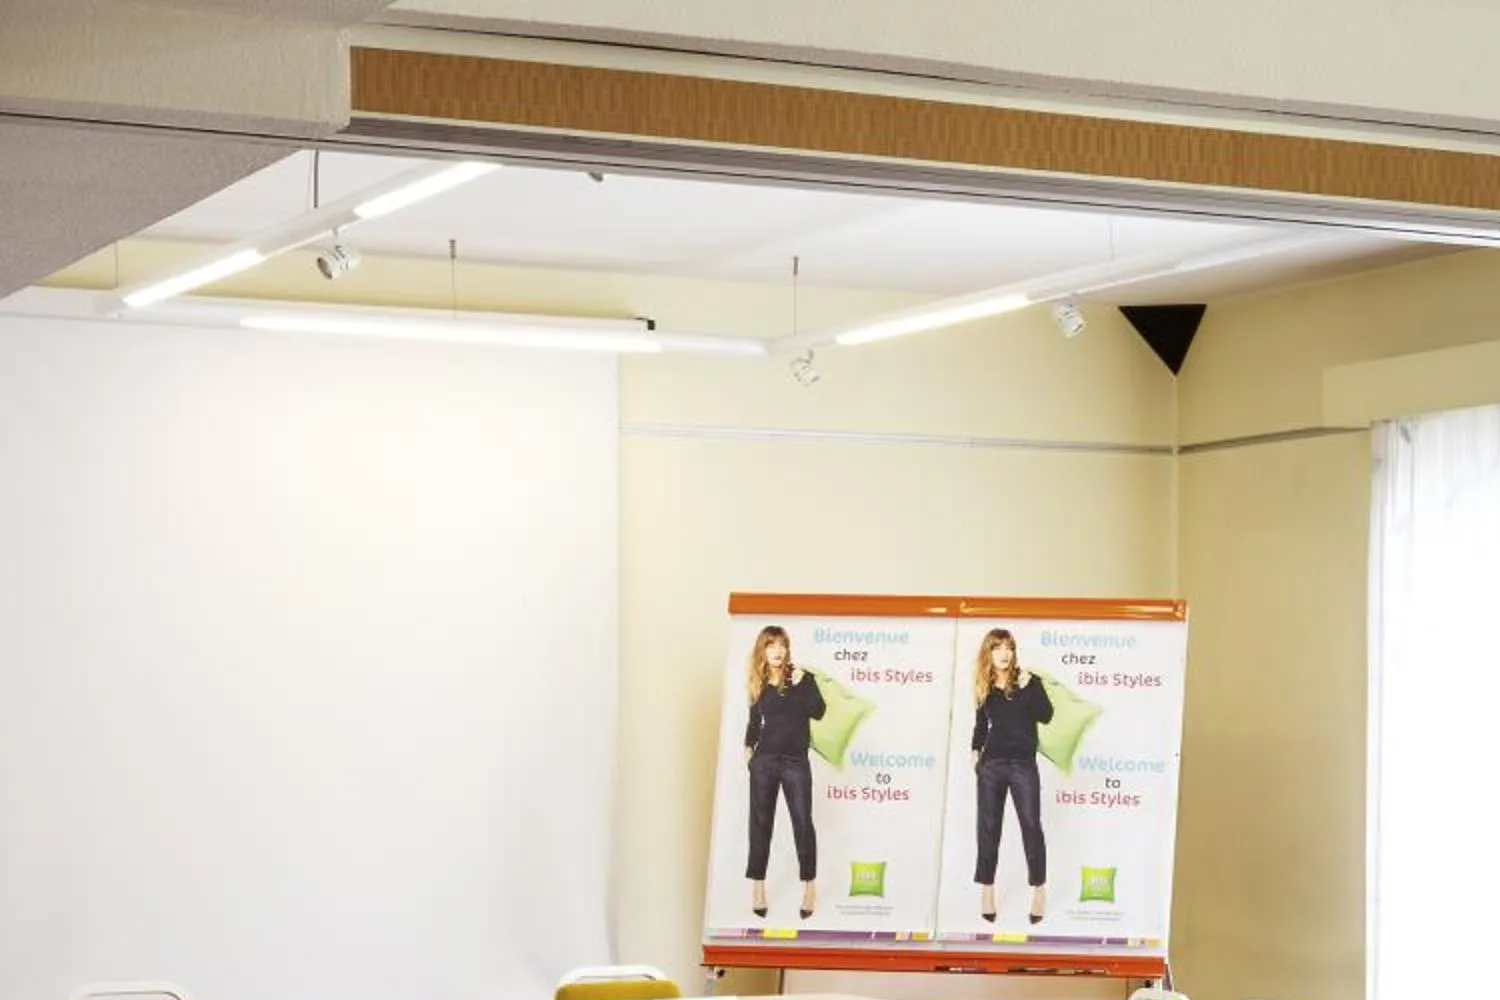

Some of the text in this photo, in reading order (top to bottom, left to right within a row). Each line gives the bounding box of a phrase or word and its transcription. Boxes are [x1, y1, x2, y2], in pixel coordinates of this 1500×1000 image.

[814, 628, 910, 645] Bienvenue
[1041, 631, 1136, 649] Bienvenue
[834, 648, 868, 662] chez
[1061, 652, 1096, 665] chez
[850, 667, 934, 685] ibis Styles
[1077, 671, 1162, 689] ibis Styles
[850, 750, 936, 768] Welcome
[1078, 755, 1165, 773] Welcome
[875, 771, 892, 785] to
[1105, 777, 1121, 789] to
[827, 786, 910, 803] ibis Styles
[1055, 790, 1142, 808] ibis Styles
